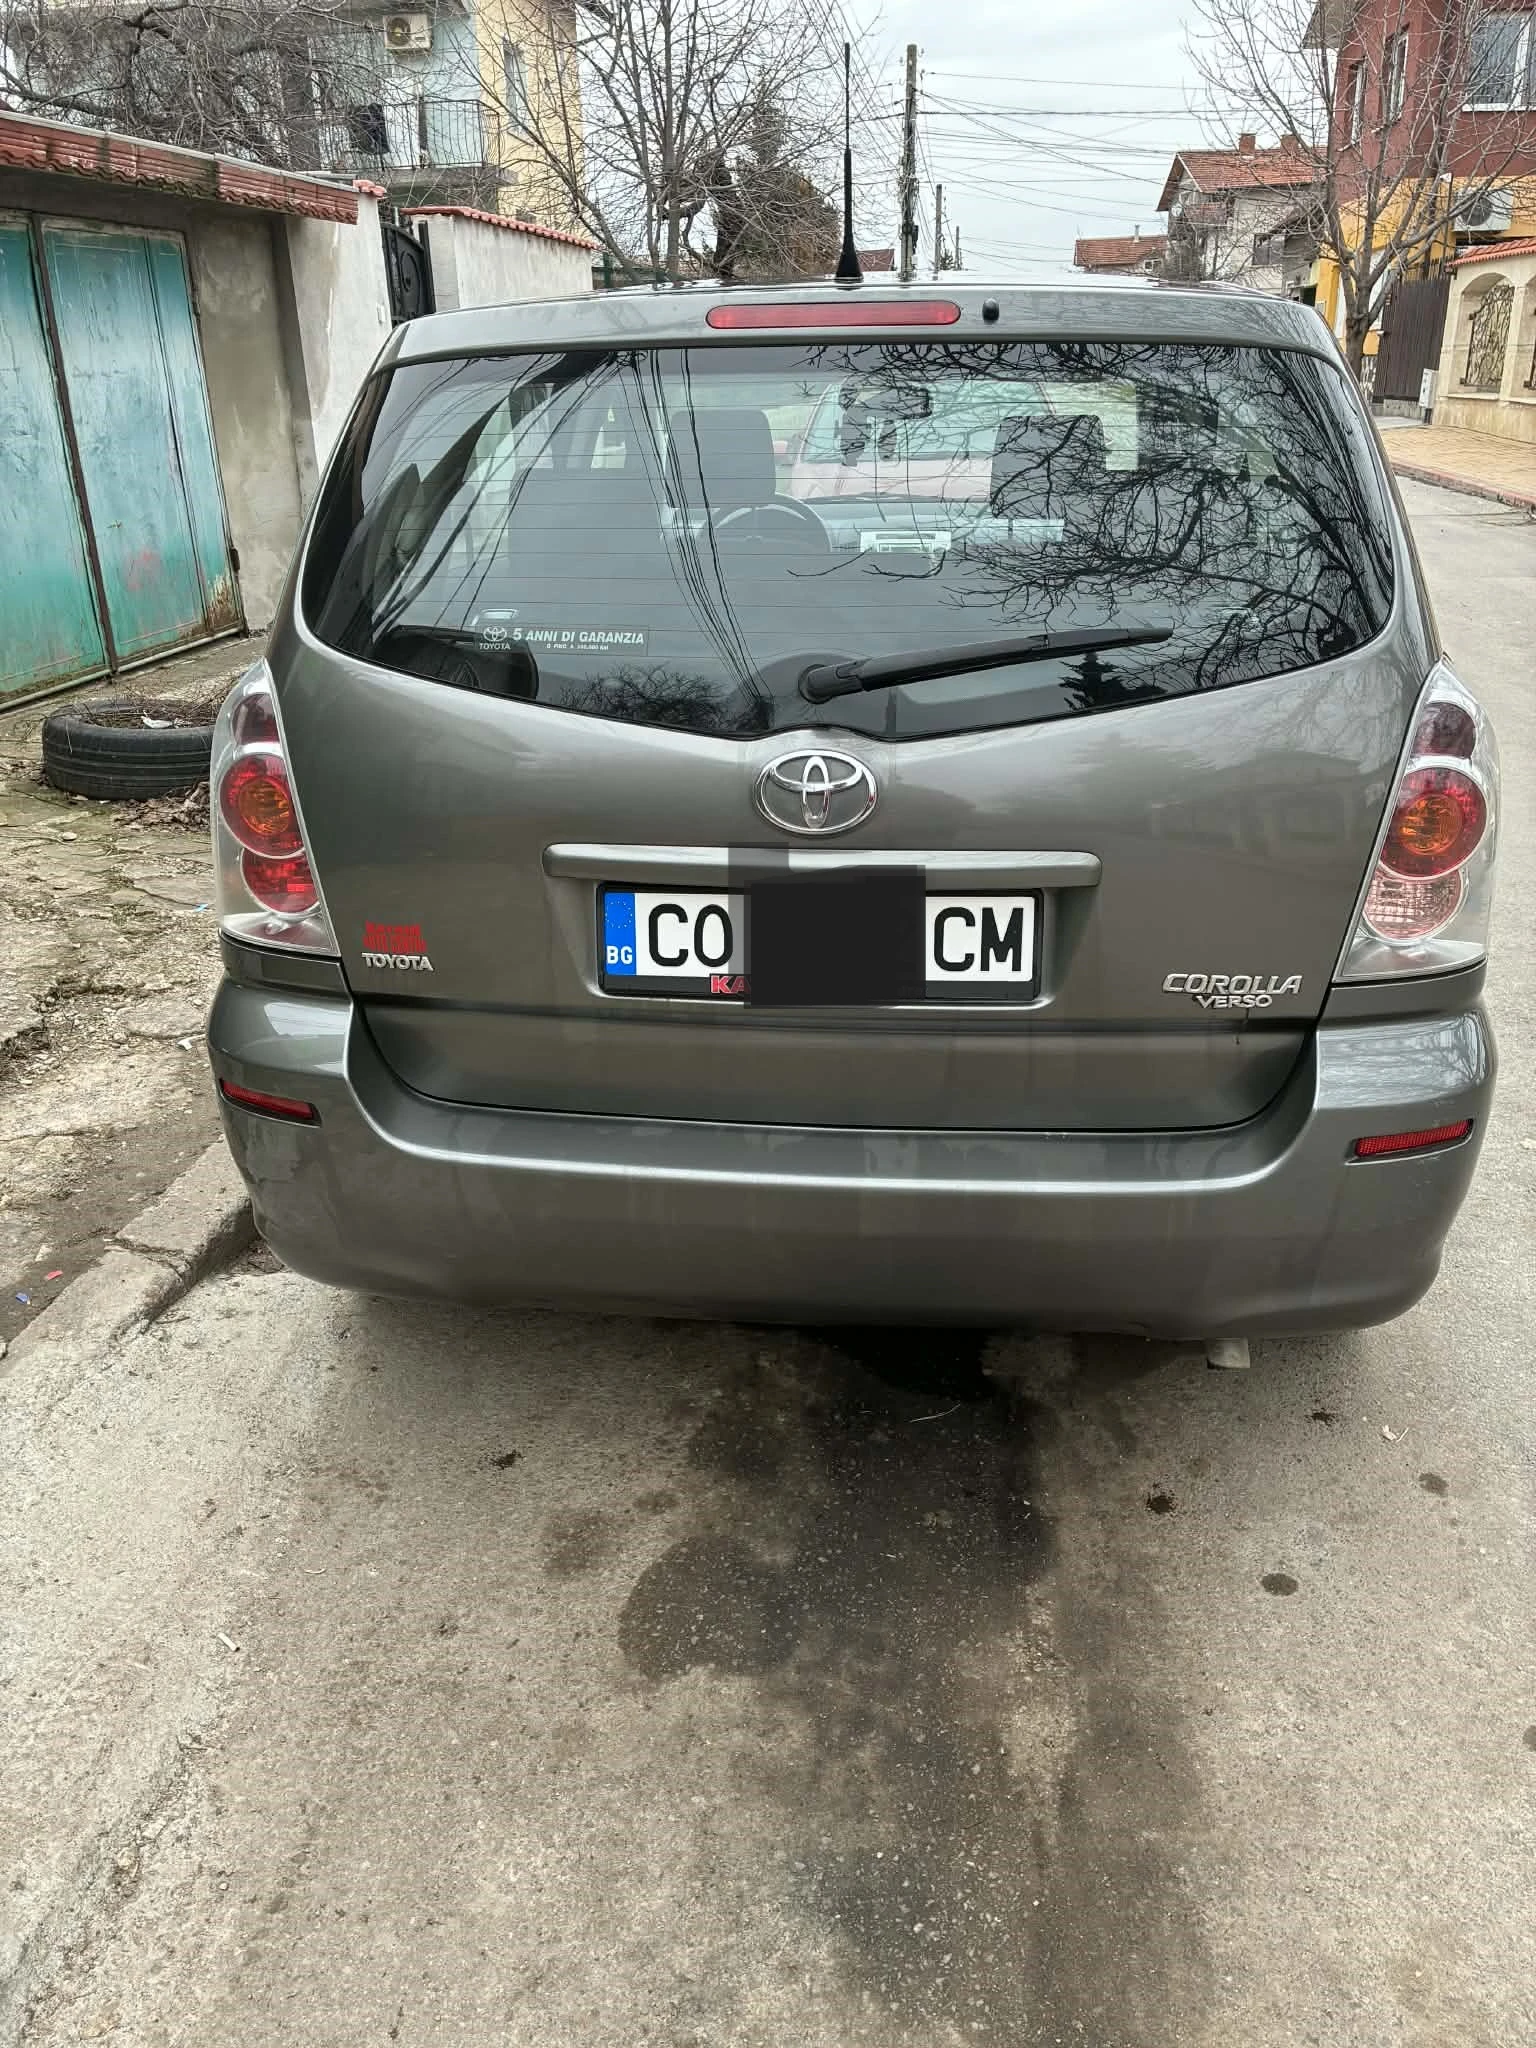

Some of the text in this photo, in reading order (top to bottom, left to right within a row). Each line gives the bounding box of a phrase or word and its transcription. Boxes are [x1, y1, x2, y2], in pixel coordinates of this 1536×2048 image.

[479, 642, 511, 650] TOYOTA
[512, 628, 644, 645] 5 ANNI DI GARANZIA
[934, 907, 1025, 972] CM
[361, 952, 434, 972] TOYOTA
[606, 945, 633, 965] BG
[1162, 973, 1303, 994] COROLLA
[1195, 994, 1272, 1009] VERSO
